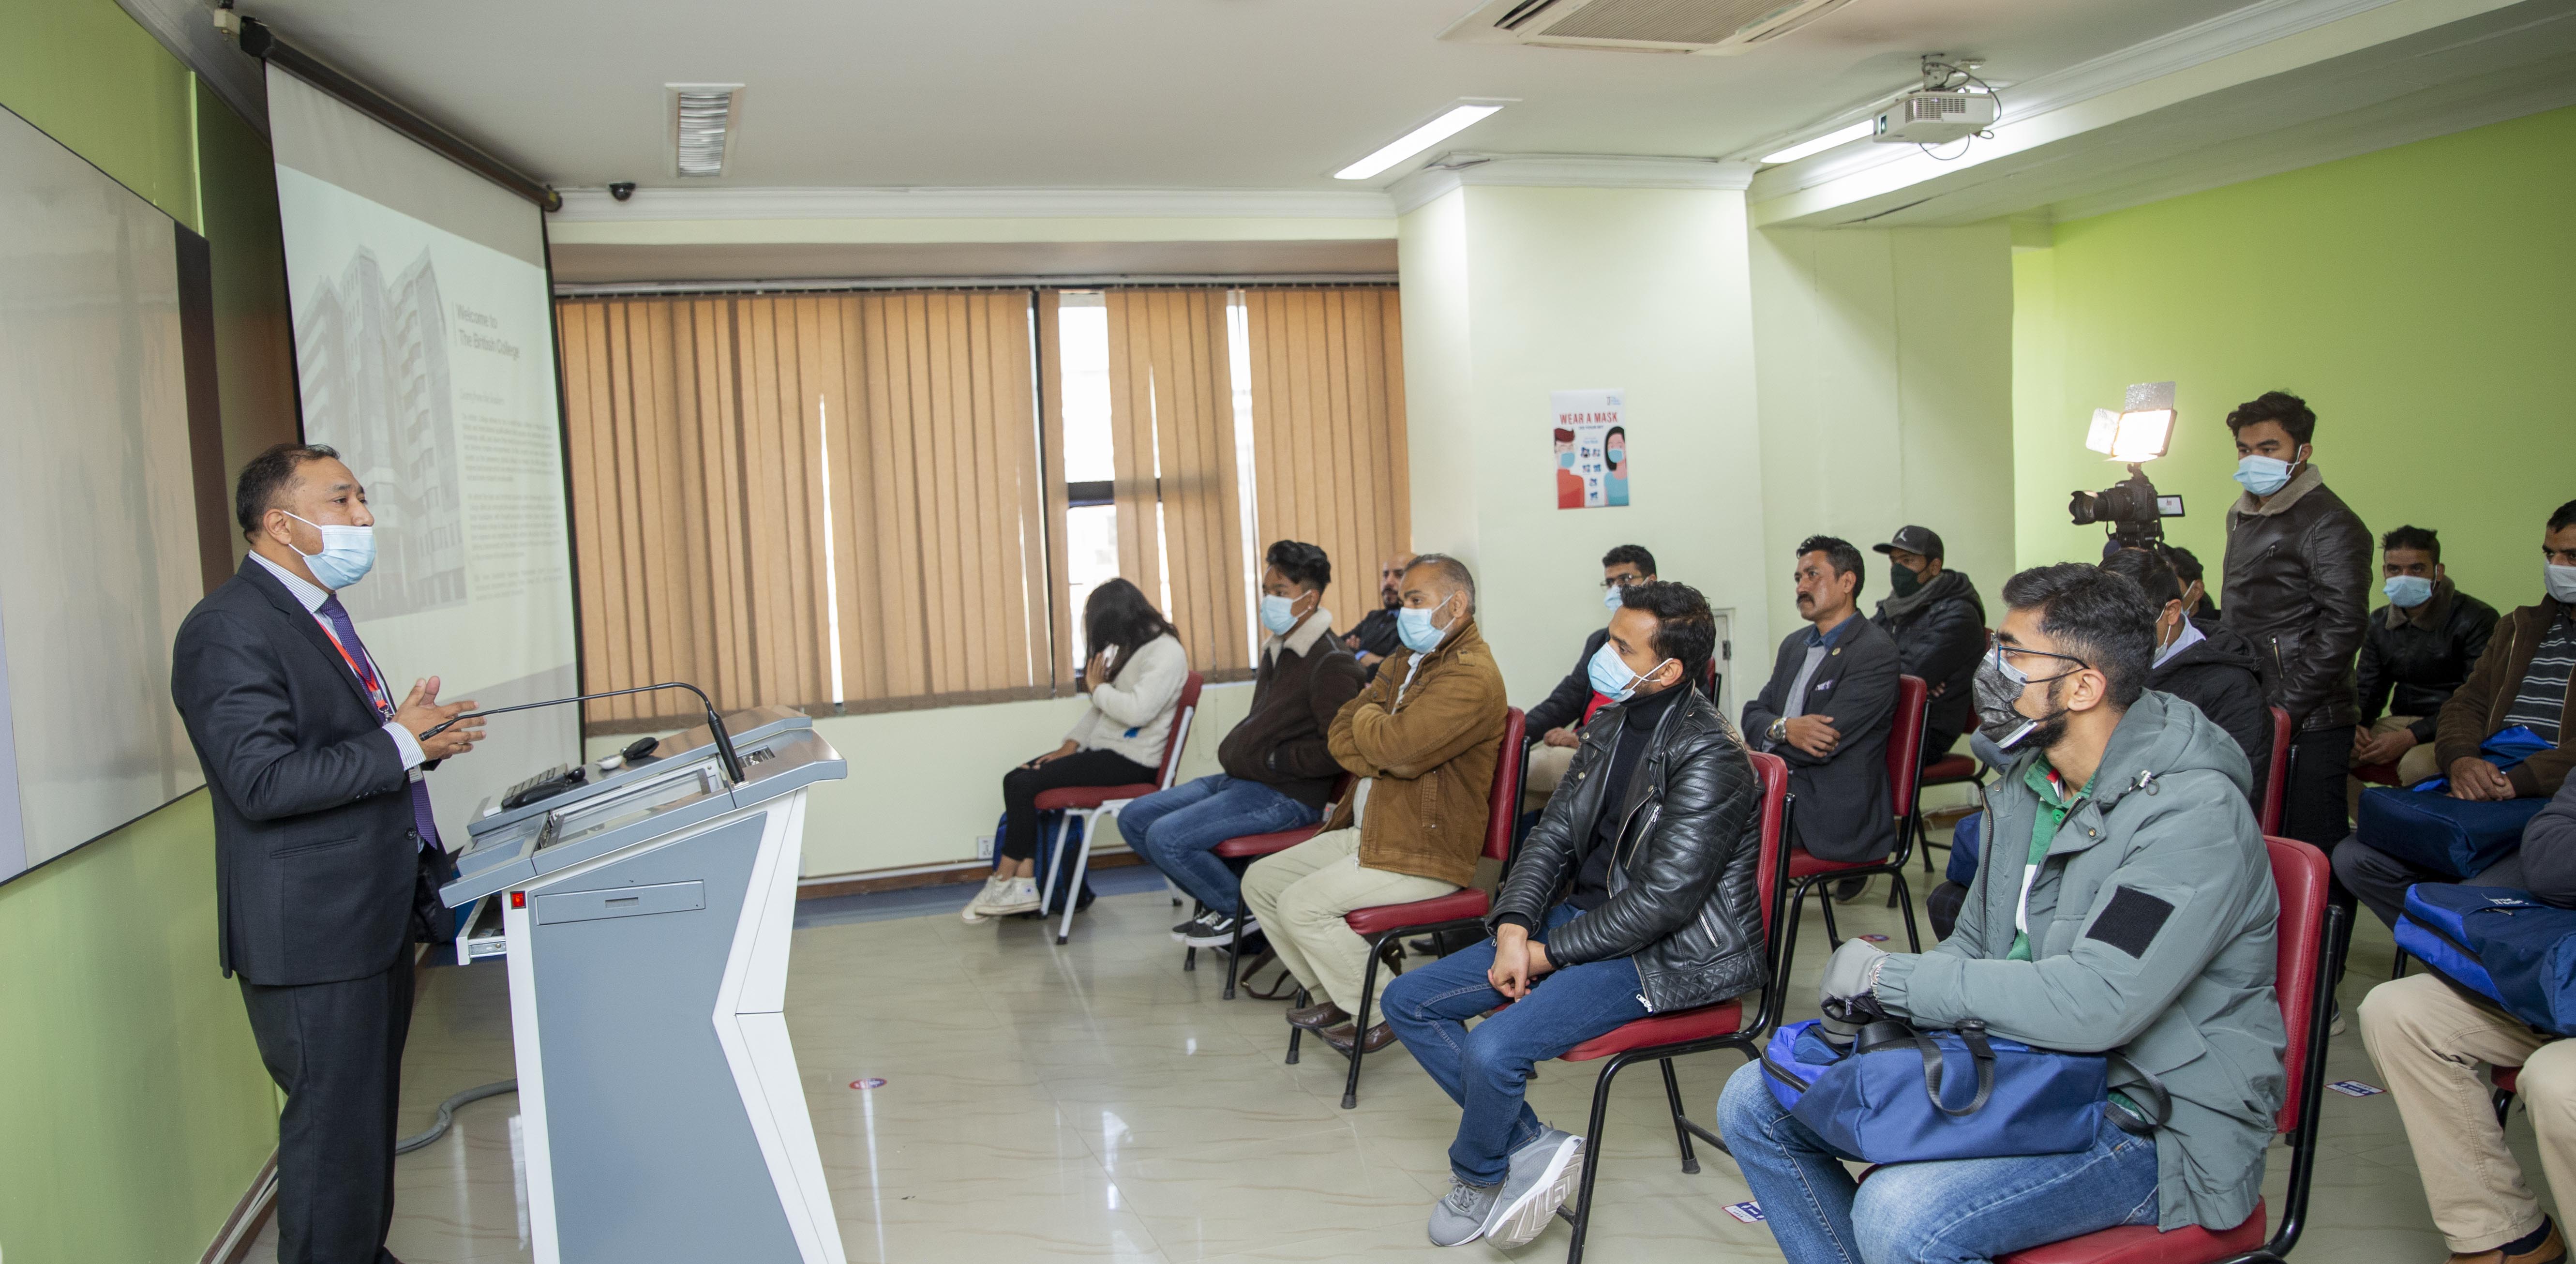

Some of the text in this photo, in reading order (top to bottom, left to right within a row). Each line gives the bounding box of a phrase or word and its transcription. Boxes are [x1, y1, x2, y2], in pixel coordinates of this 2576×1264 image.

[455, 303, 498, 329] Welcome to
[458, 329, 520, 361] The British College
[1559, 412, 1618, 424] WEAR A MASK
